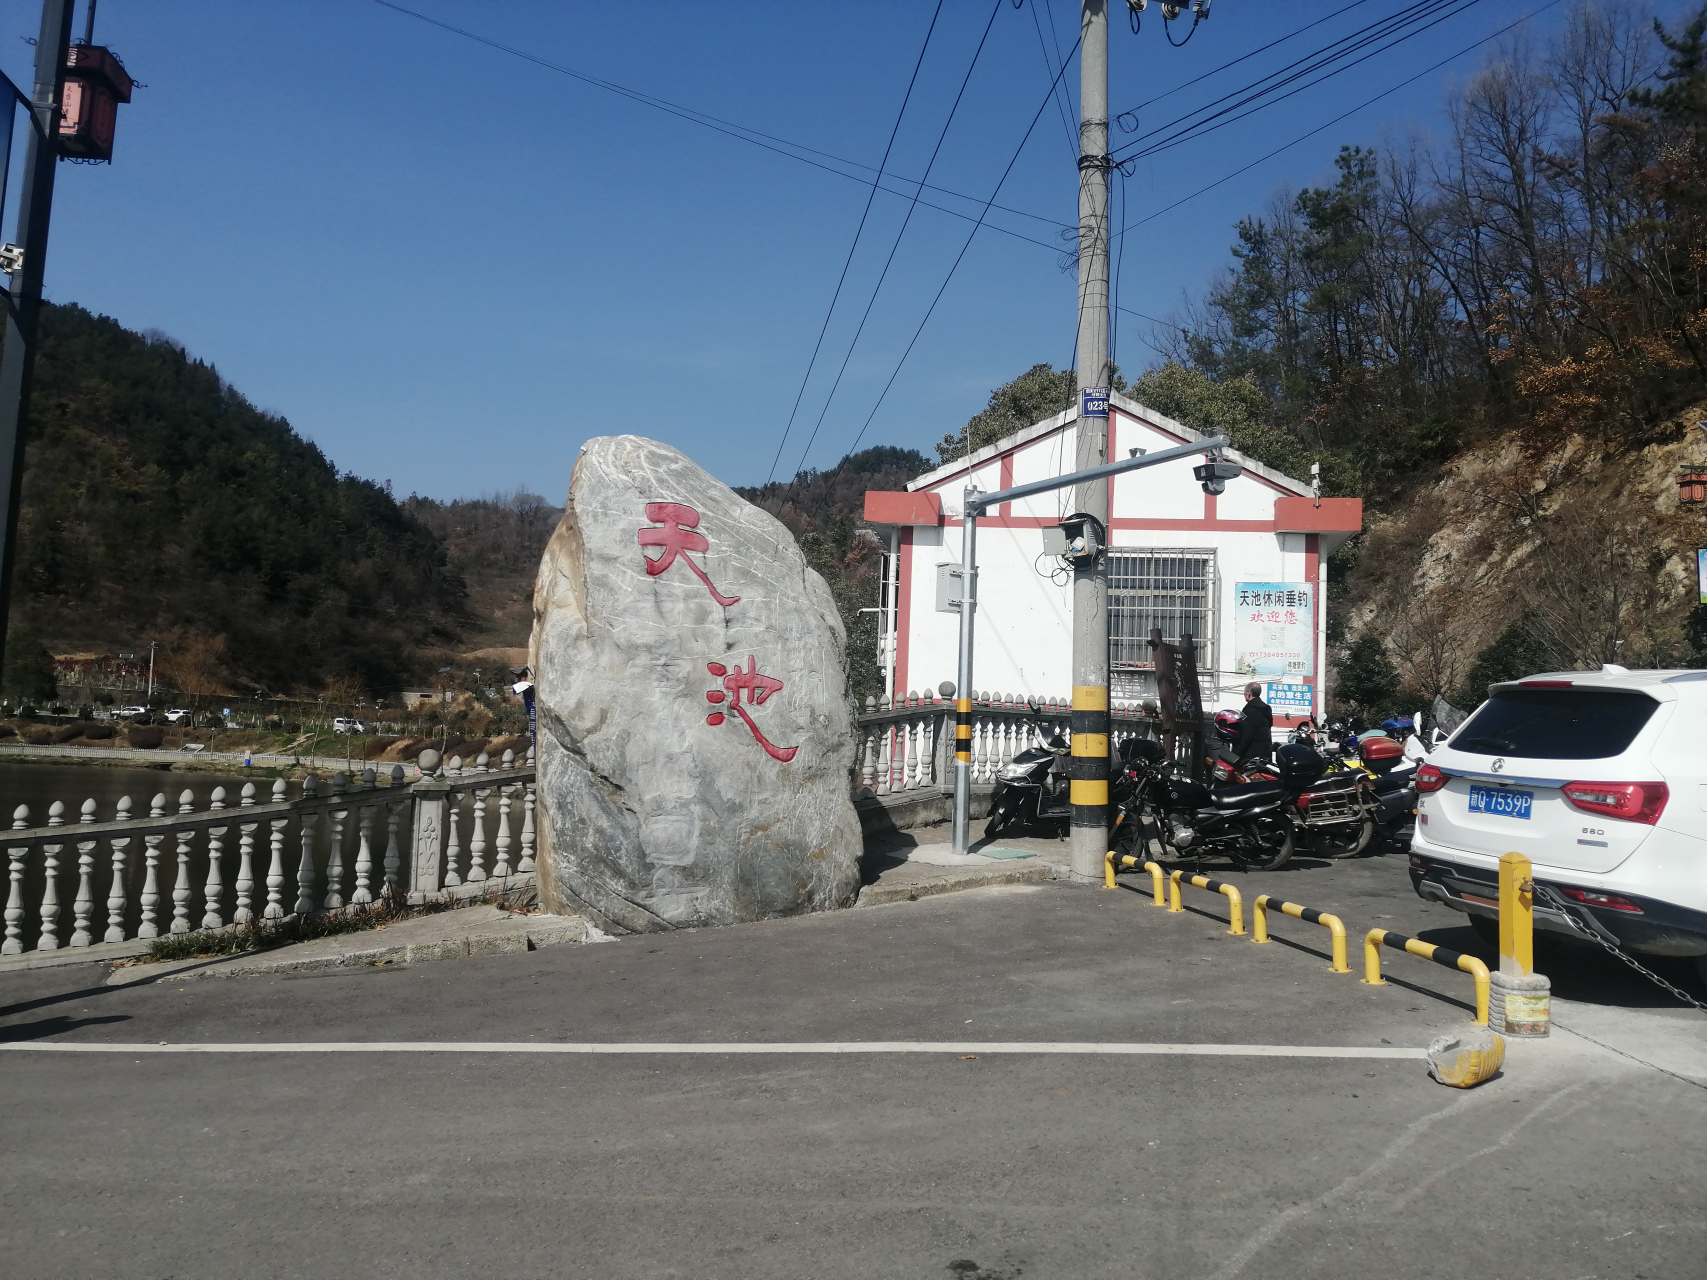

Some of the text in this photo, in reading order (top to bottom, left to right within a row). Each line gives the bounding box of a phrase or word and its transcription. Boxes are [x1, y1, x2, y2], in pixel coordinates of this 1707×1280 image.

[1239, 589, 1308, 608] 天池休闲垂钓
[1250, 609, 1298, 625] 欢迎您
[638, 502, 799, 763] 天池
